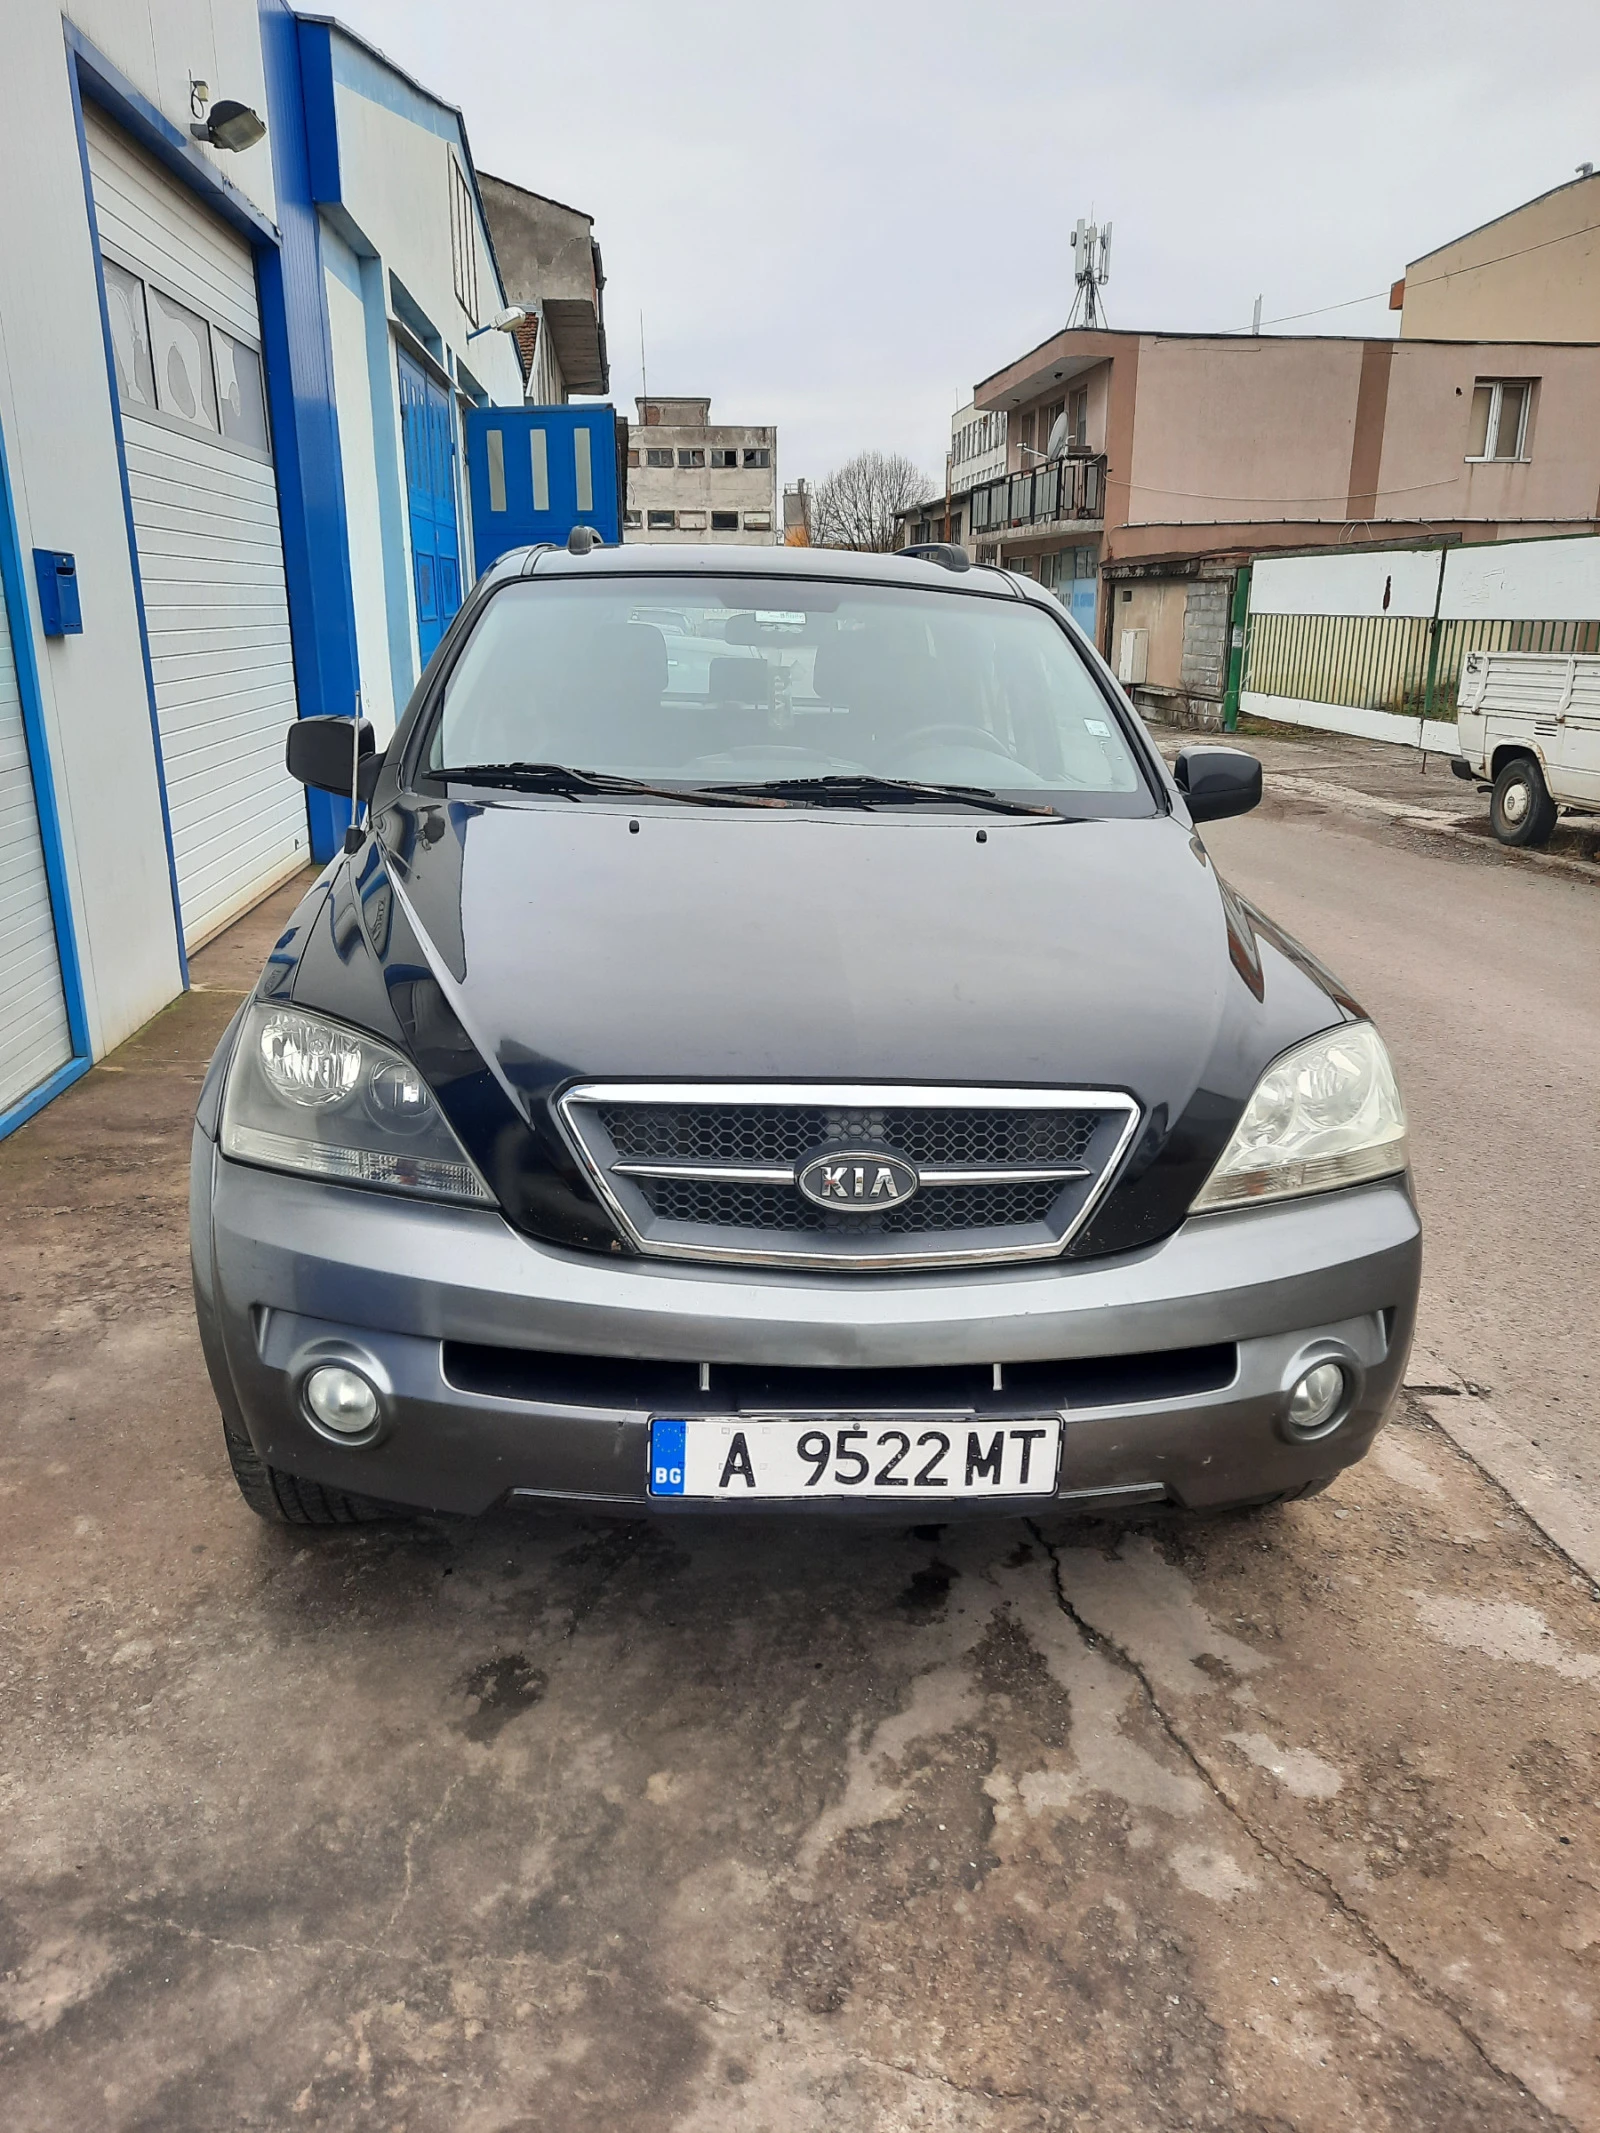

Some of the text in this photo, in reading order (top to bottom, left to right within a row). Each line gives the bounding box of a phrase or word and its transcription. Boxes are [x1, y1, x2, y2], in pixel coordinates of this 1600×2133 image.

[820, 1167, 899, 1197] KIA
[718, 1431, 1046, 1487] A 9522 MT
[654, 1467, 681, 1483] BG
